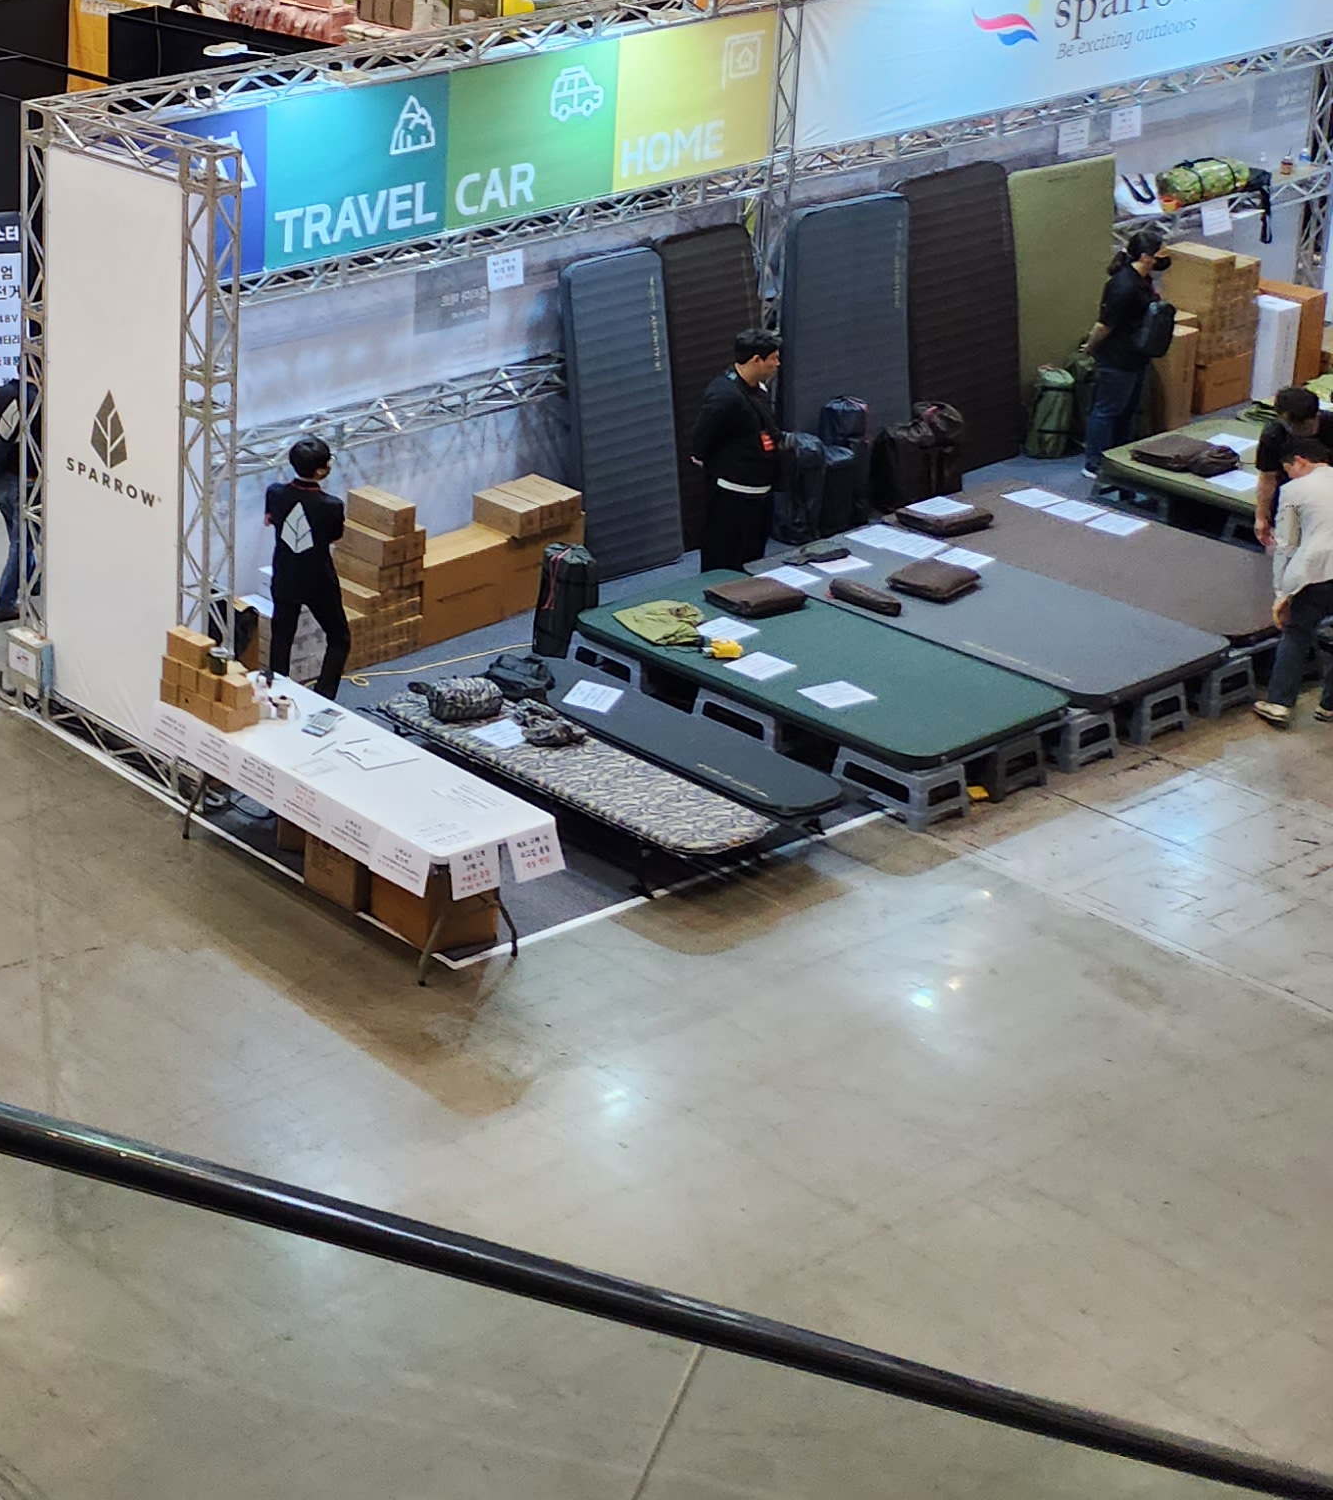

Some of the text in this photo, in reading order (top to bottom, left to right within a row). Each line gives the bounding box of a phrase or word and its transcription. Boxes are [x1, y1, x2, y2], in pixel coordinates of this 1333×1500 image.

[1055, 17, 1198, 60] Be exciting outdoors
[275, 119, 724, 254] TRAVEL CAR HOME
[66, 455, 157, 509] SPARROW
